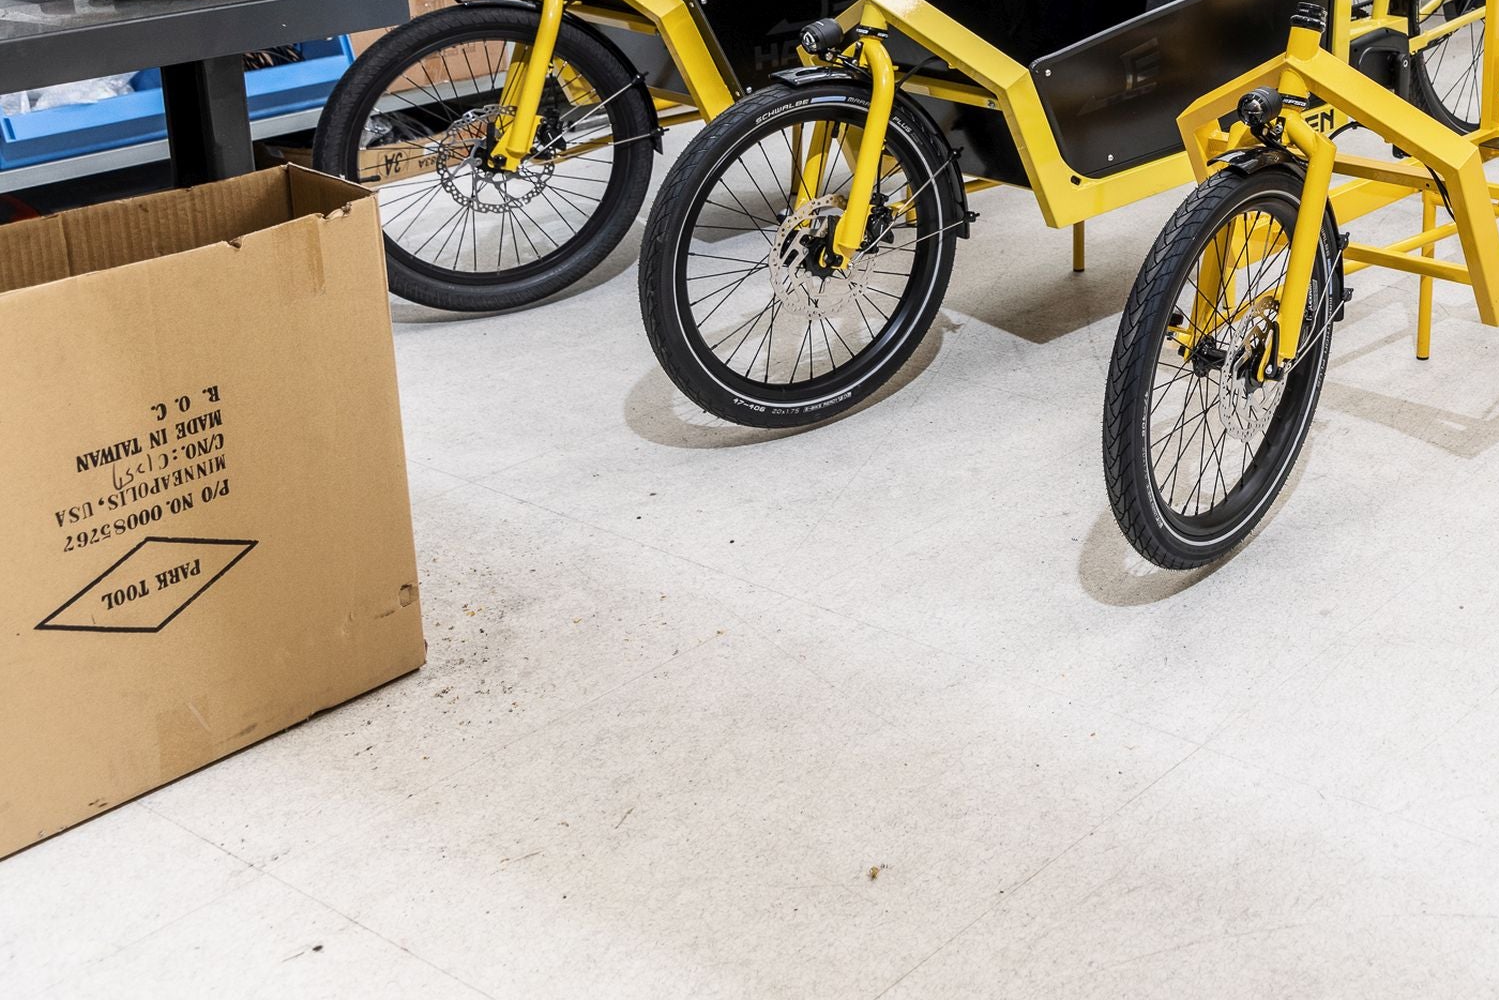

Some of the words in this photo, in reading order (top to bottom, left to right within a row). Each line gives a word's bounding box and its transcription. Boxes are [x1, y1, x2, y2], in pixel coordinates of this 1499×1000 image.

[755, 98, 810, 126] SCHWALBE
[891, 115, 913, 133] PLUS
[149, 427, 168, 450] IN
[175, 410, 223, 441] MADE
[76, 437, 143, 474] TAIWAN
[201, 478, 230, 504] P/O
[54, 500, 93, 529] USA
[154, 558, 202, 591] PARK
[101, 579, 150, 611] TOOL
